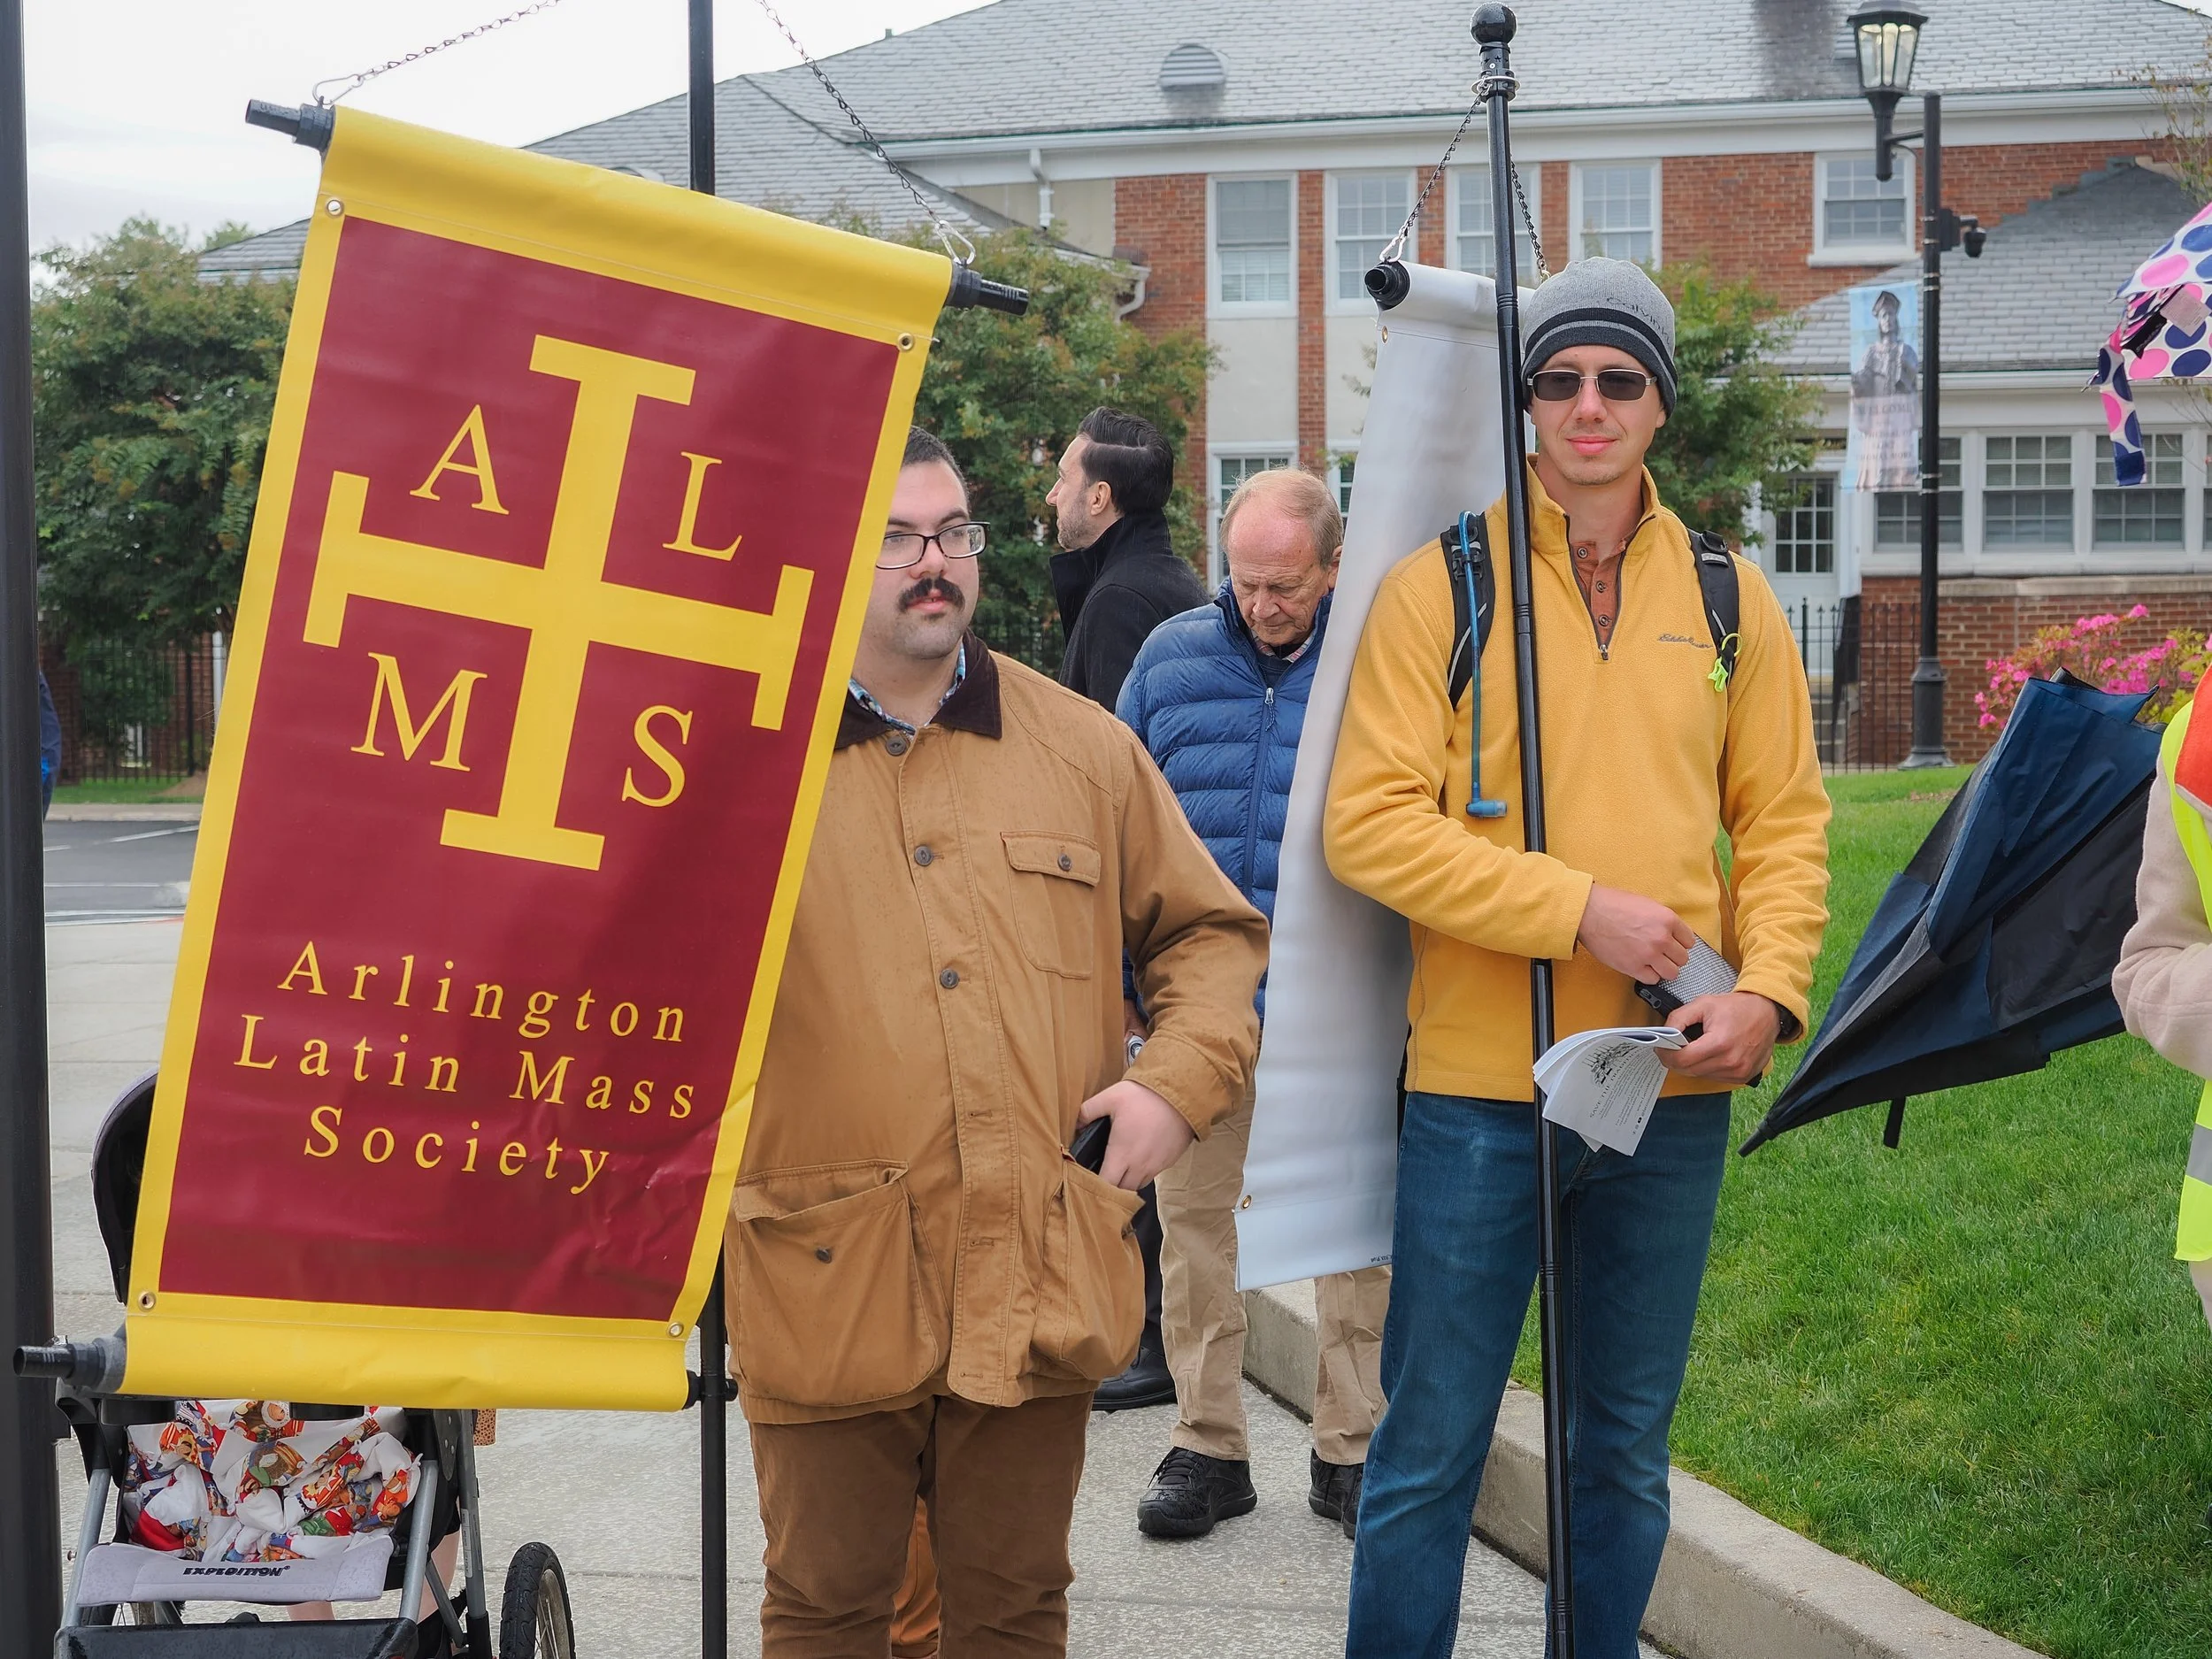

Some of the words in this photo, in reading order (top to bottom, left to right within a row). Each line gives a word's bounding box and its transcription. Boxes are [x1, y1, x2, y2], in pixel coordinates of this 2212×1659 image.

[410, 404, 510, 515] A
[663, 451, 742, 561] L
[350, 651, 488, 772] M
[621, 704, 694, 808] S
[277, 941, 685, 1043] Arlington
[234, 1014, 460, 1094] Latin
[509, 1050, 695, 1118] Mass
[303, 1105, 610, 1194] Society
